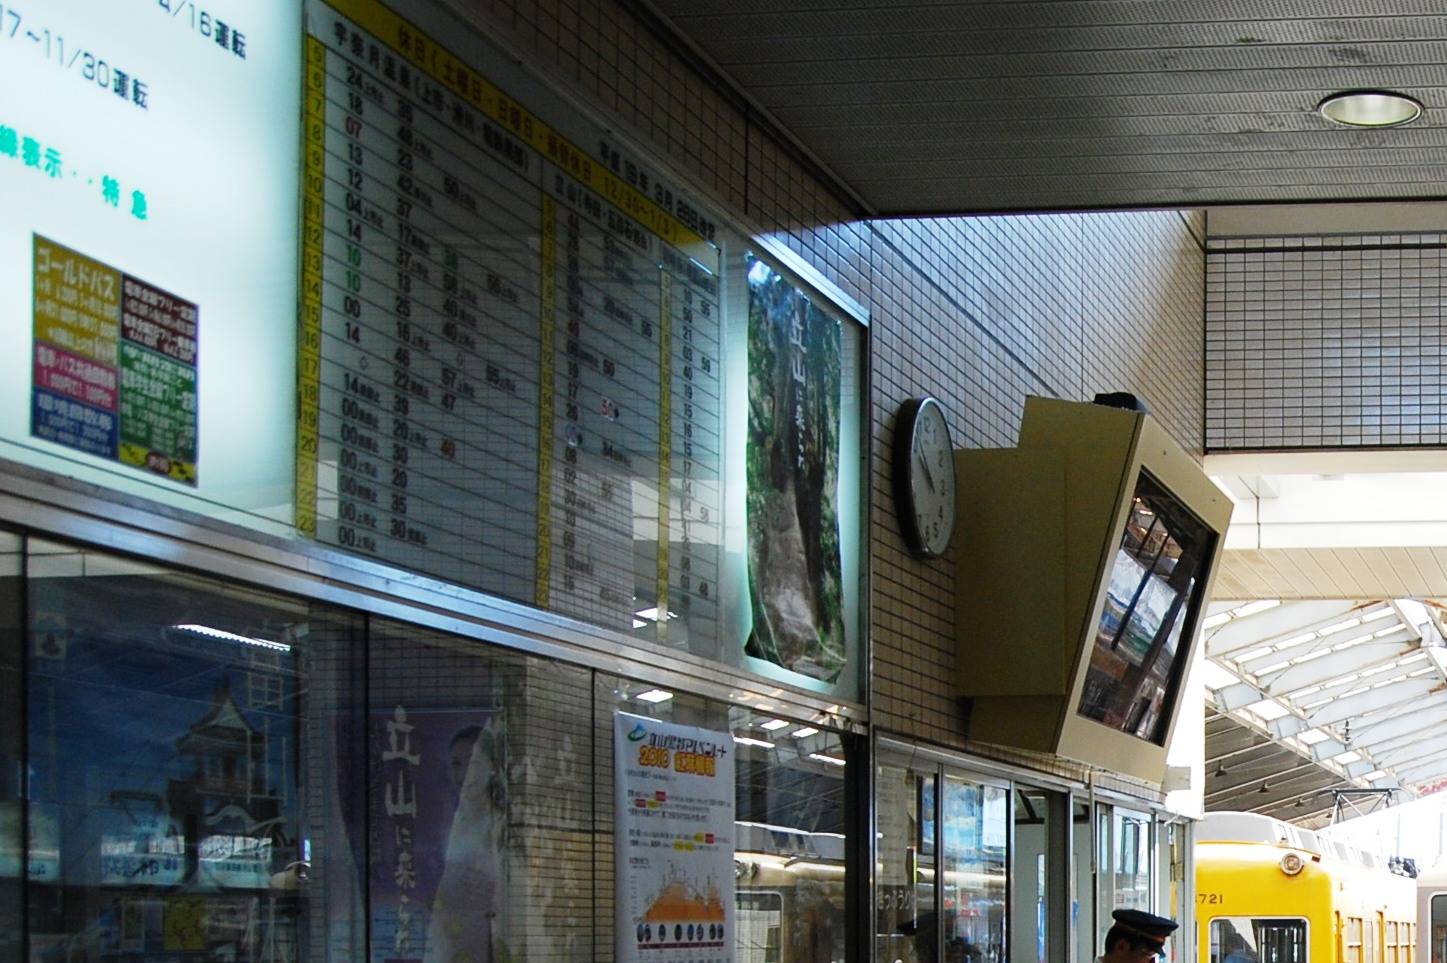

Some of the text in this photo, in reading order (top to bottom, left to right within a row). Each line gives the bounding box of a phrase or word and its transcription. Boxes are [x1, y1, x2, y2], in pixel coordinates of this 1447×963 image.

[313, 70, 321, 90] 6
[346, 65, 363, 91] 24
[313, 95, 321, 115] 7
[345, 115, 362, 140] 07
[312, 120, 320, 140] 8
[344, 140, 361, 165] 13
[312, 147, 320, 167] 9
[344, 166, 361, 190] 12
[343, 191, 360, 215] 04
[343, 218, 360, 242] 14
[343, 242, 360, 266] 10
[342, 268, 359, 291] 10
[342, 294, 359, 317] 00
[341, 319, 358, 342] 14
[340, 371, 357, 393] 14
[340, 396, 357, 418] 00
[340, 422, 357, 443] 00
[339, 447, 356, 468] 00
[639, 745, 672, 769] 2010
[1196, 893, 1224, 905] 721
